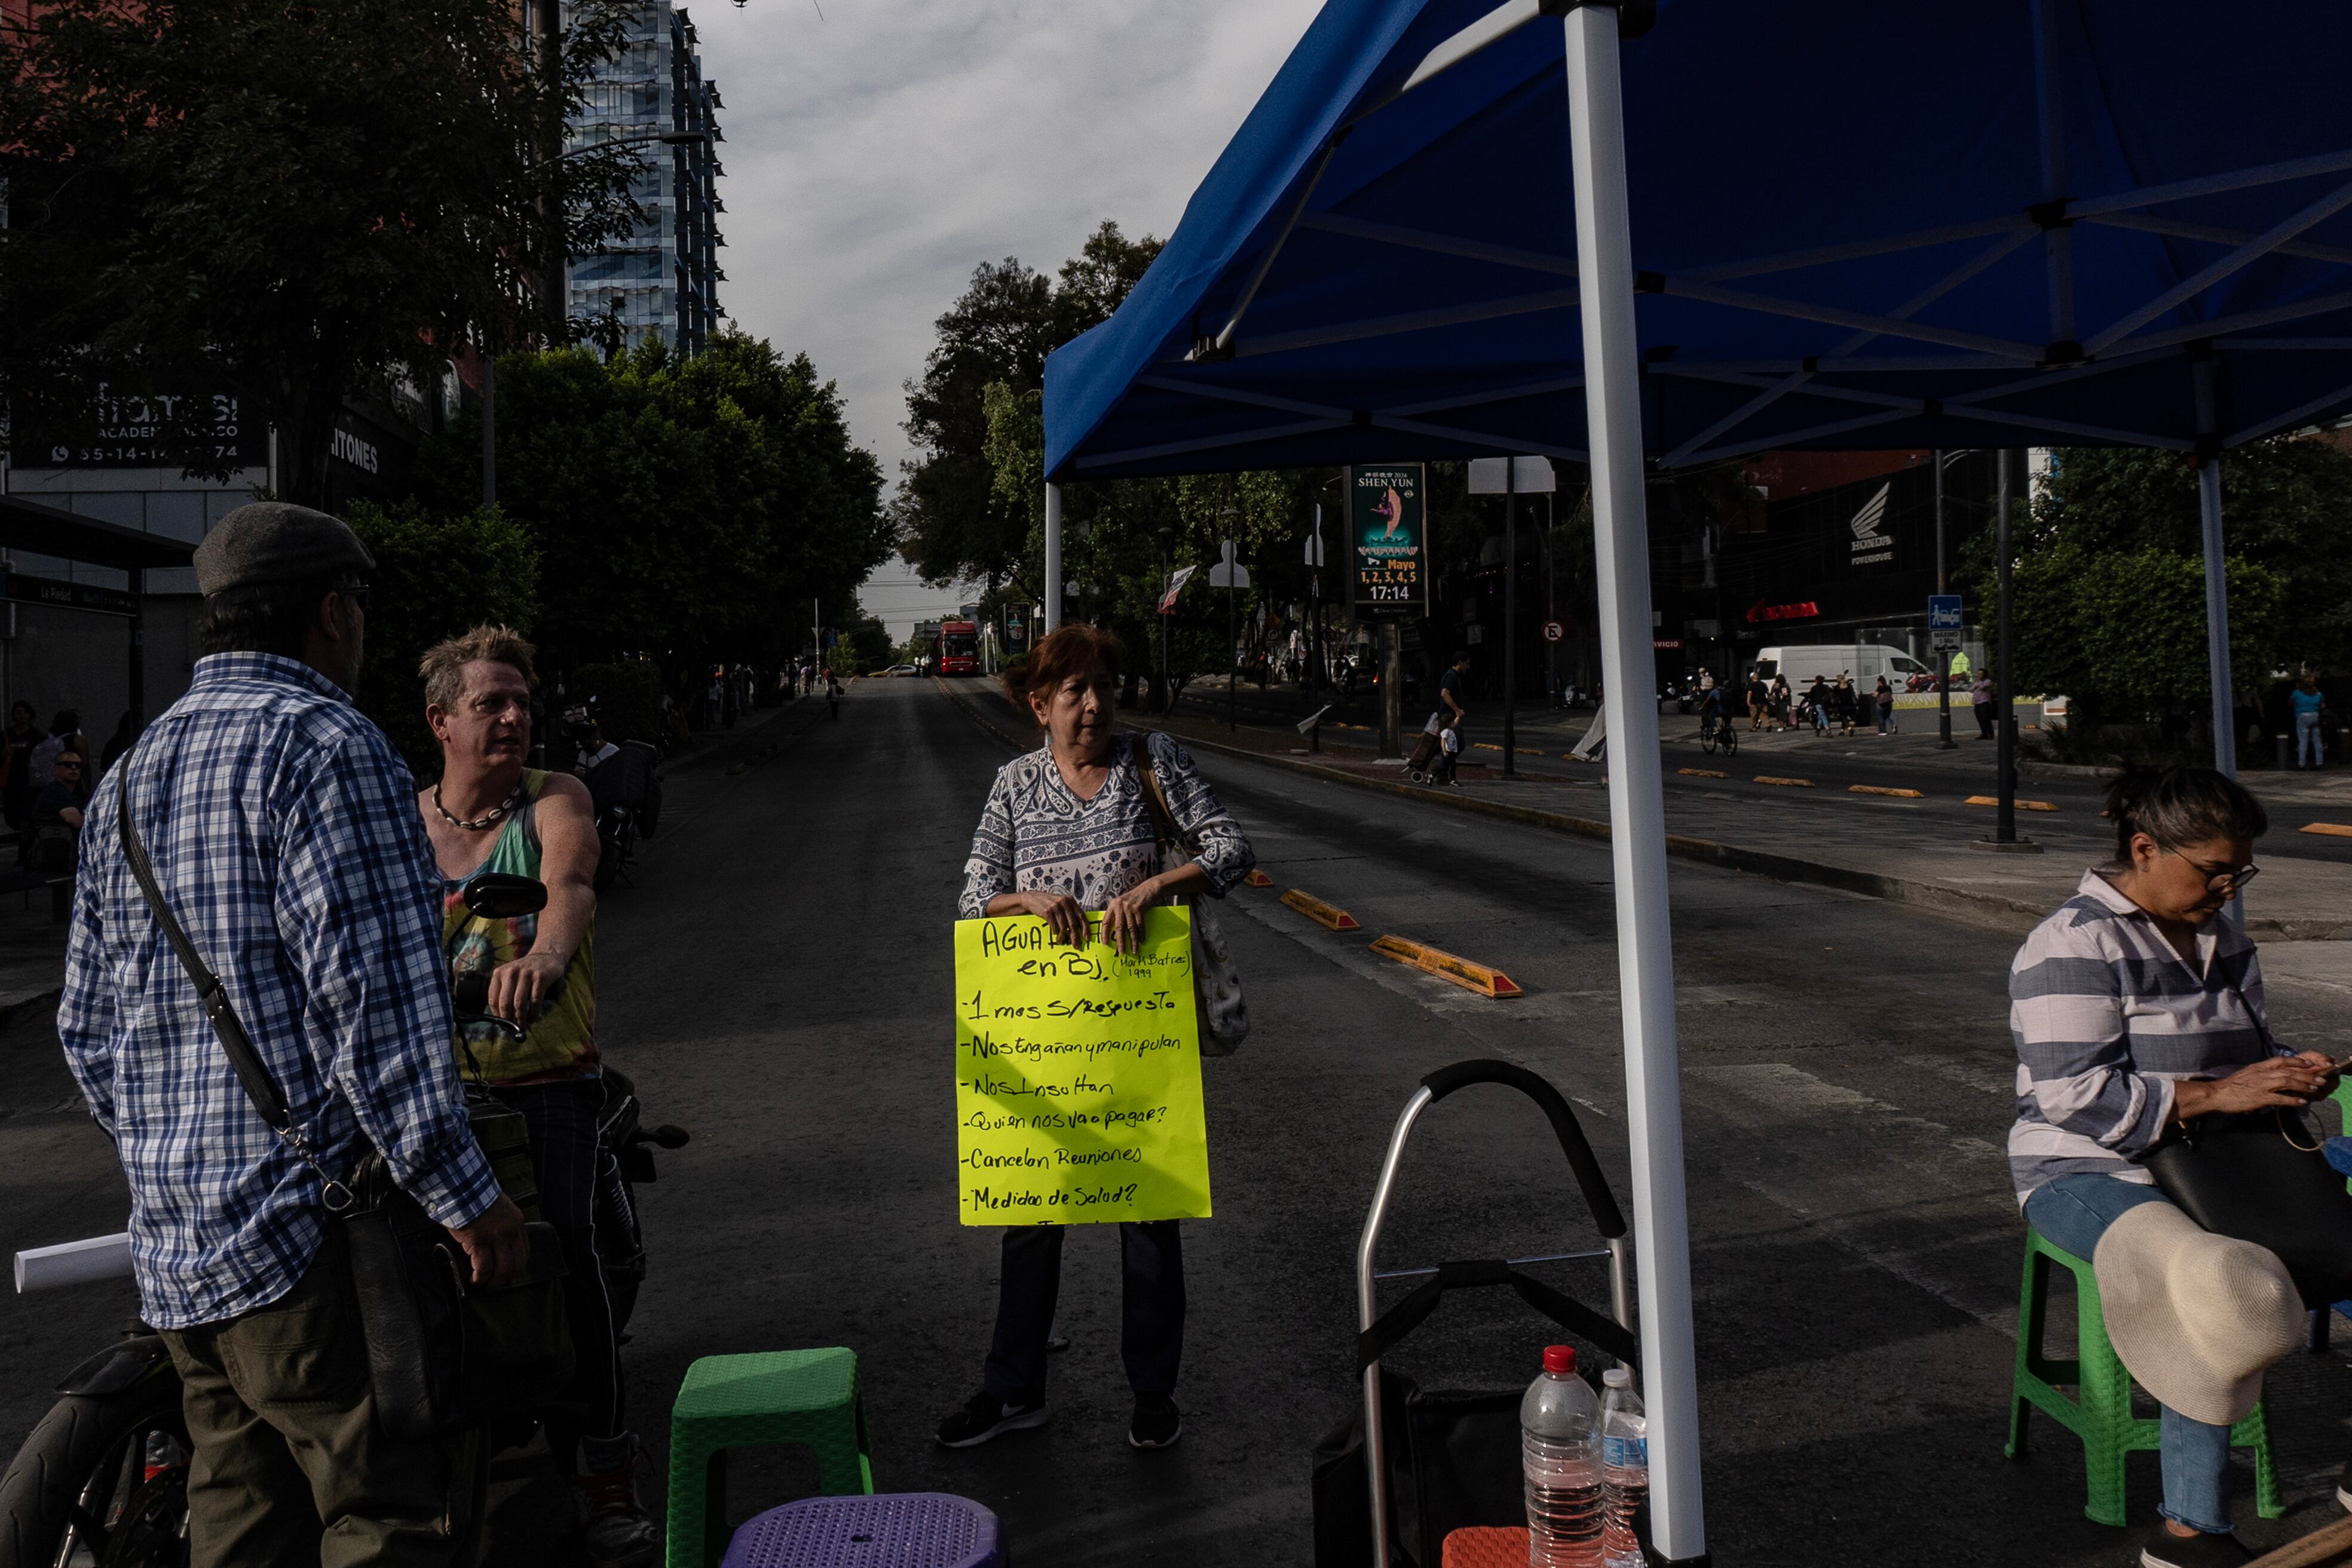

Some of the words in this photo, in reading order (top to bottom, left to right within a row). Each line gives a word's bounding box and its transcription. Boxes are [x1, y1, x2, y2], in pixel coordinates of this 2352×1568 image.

[1358, 478, 1388, 487] SHEN
[1391, 478, 1414, 487] YUN
[1851, 535, 1893, 551] HONDA
[1388, 559, 1416, 572] Mayo
[1361, 571, 1370, 584] 1,
[1372, 571, 1383, 584] 2,
[1385, 571, 1395, 584] 3,
[1397, 571, 1408, 584] 4,
[1410, 571, 1417, 583] 5
[1370, 586, 1410, 600] 17:14
[982, 920, 1042, 957] AGUA
[1017, 960, 1056, 977] en
[1129, 968, 1152, 978] 1999
[994, 1004, 1042, 1019] mes
[1086, 1044, 1094, 1062] y
[1095, 1034, 1181, 1057] manipulan
[1031, 1112, 1065, 1129] nos
[1054, 1147, 1143, 1166] Reuniones
[1048, 1189, 1070, 1206] de
[1075, 1183, 1138, 1207] Salud?
